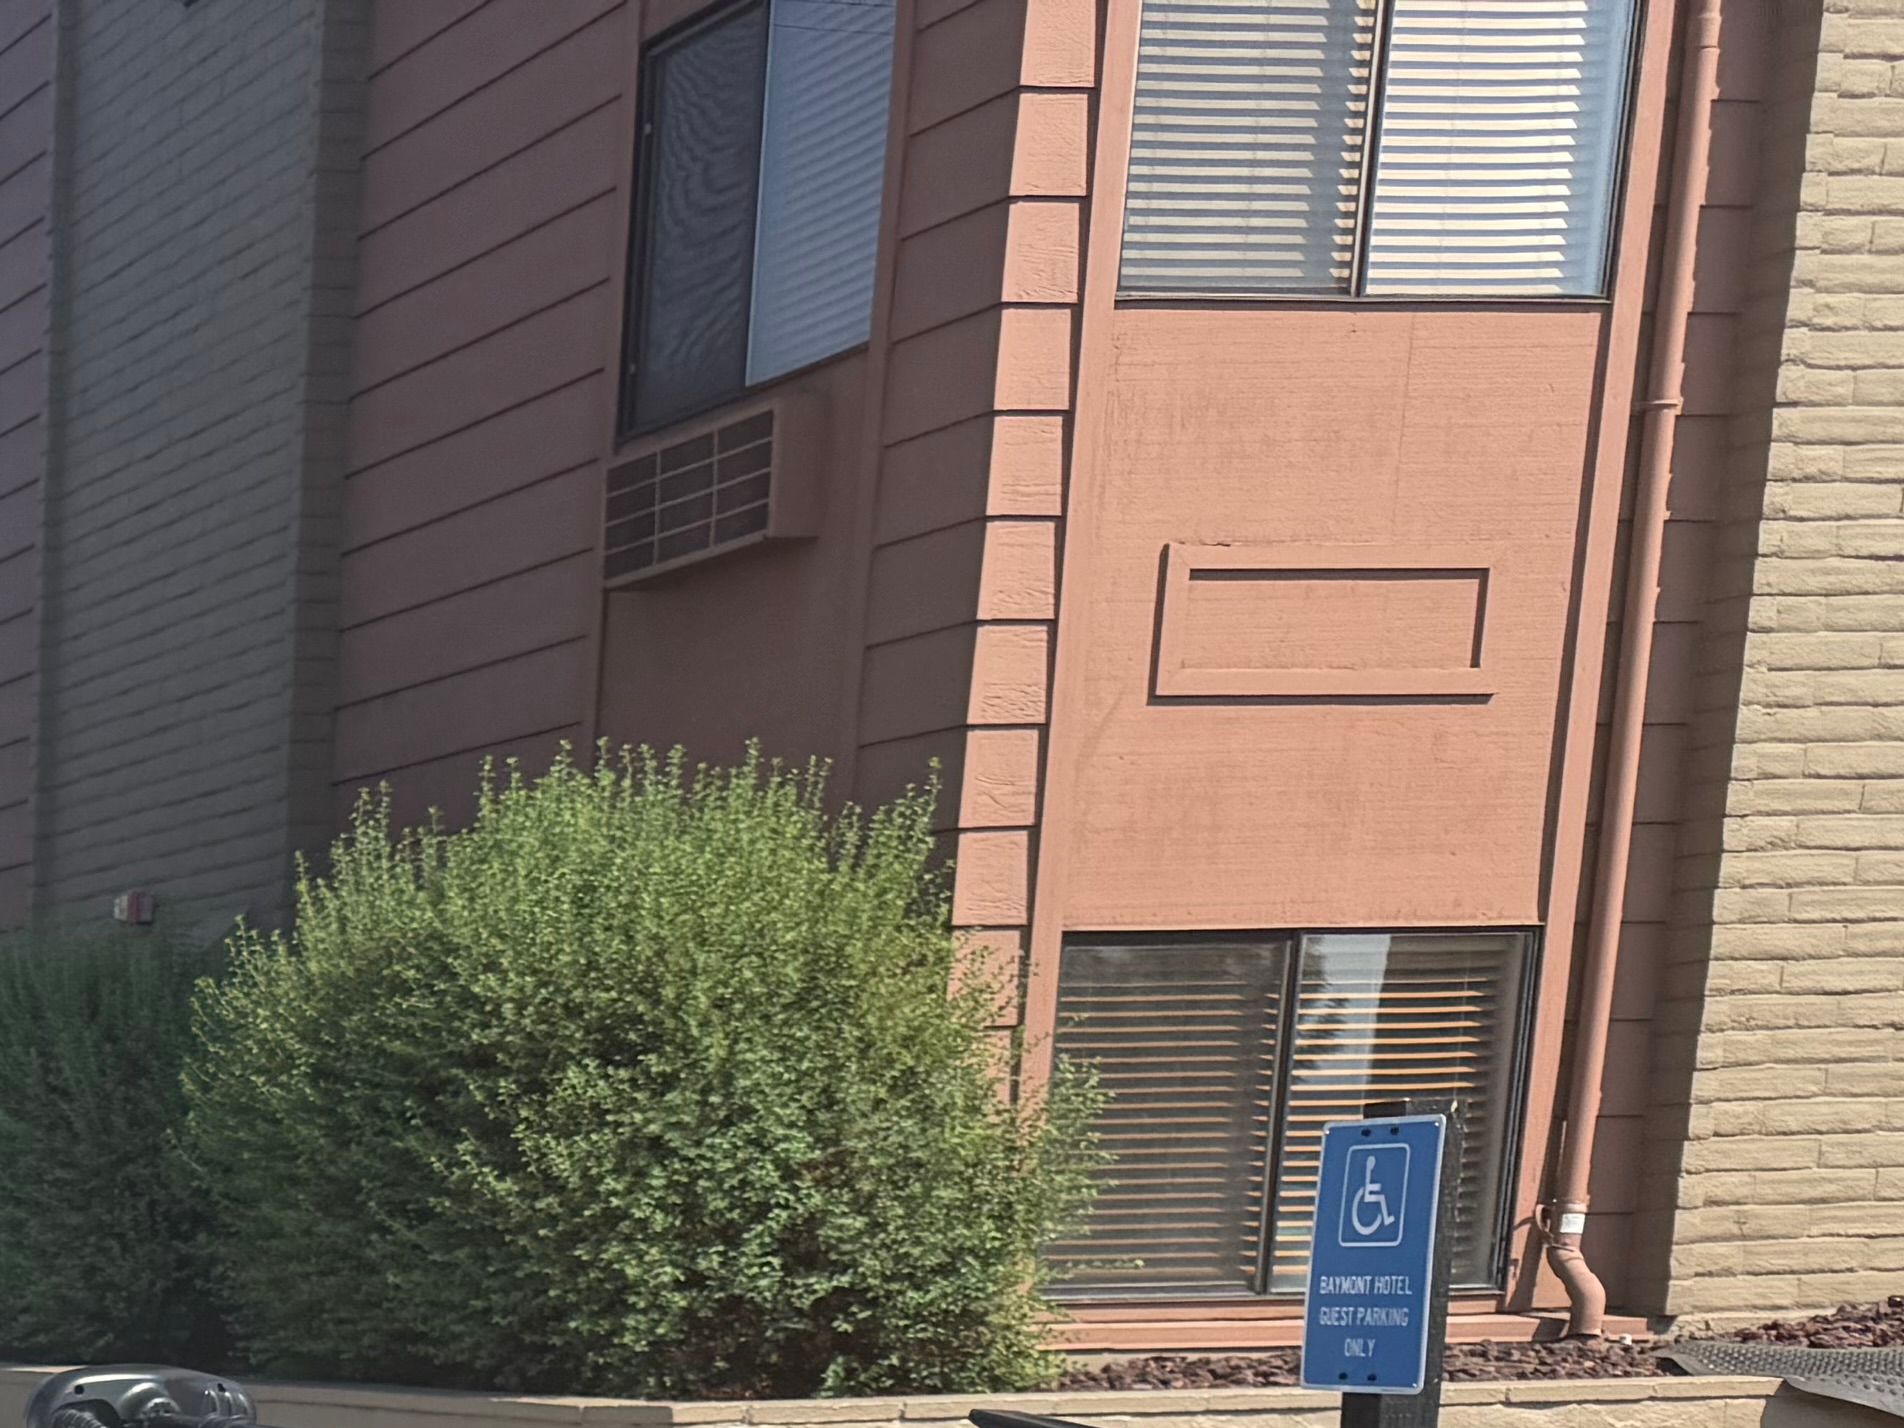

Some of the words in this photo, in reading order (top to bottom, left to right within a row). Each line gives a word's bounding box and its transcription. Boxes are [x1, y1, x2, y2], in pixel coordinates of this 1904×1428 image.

[1320, 1275, 1371, 1295] BAYMONT
[1375, 1276, 1412, 1295] HOTEL
[1320, 1307, 1354, 1326] GUEST
[1357, 1307, 1409, 1326] PARKING
[1345, 1339, 1375, 1357] ONLY
